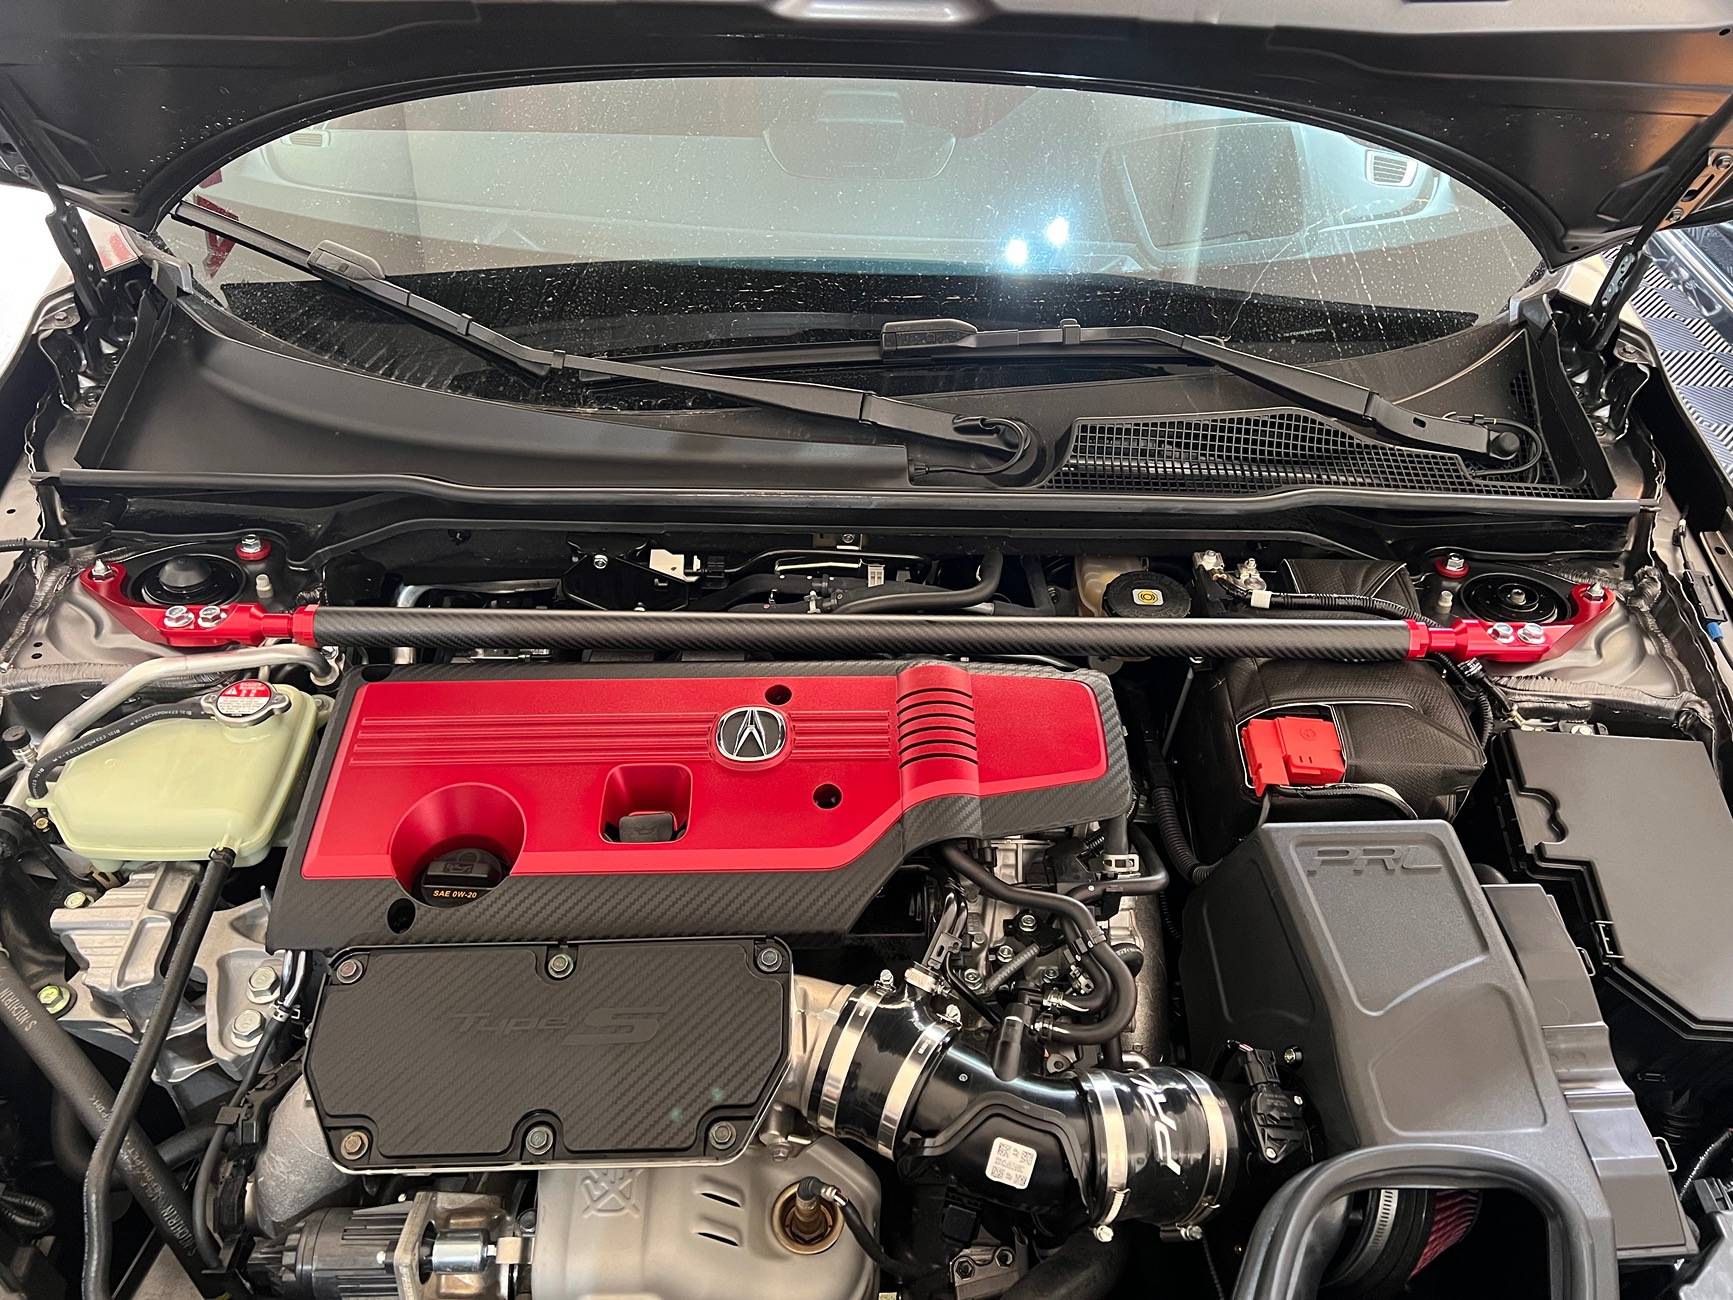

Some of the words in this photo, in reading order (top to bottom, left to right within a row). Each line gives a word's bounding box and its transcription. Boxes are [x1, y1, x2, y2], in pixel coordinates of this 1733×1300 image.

[1306, 844, 1444, 874] PRL
[452, 890, 478, 899] 0W-20
[452, 1012, 570, 1035] Type
[562, 1006, 675, 1047] S
